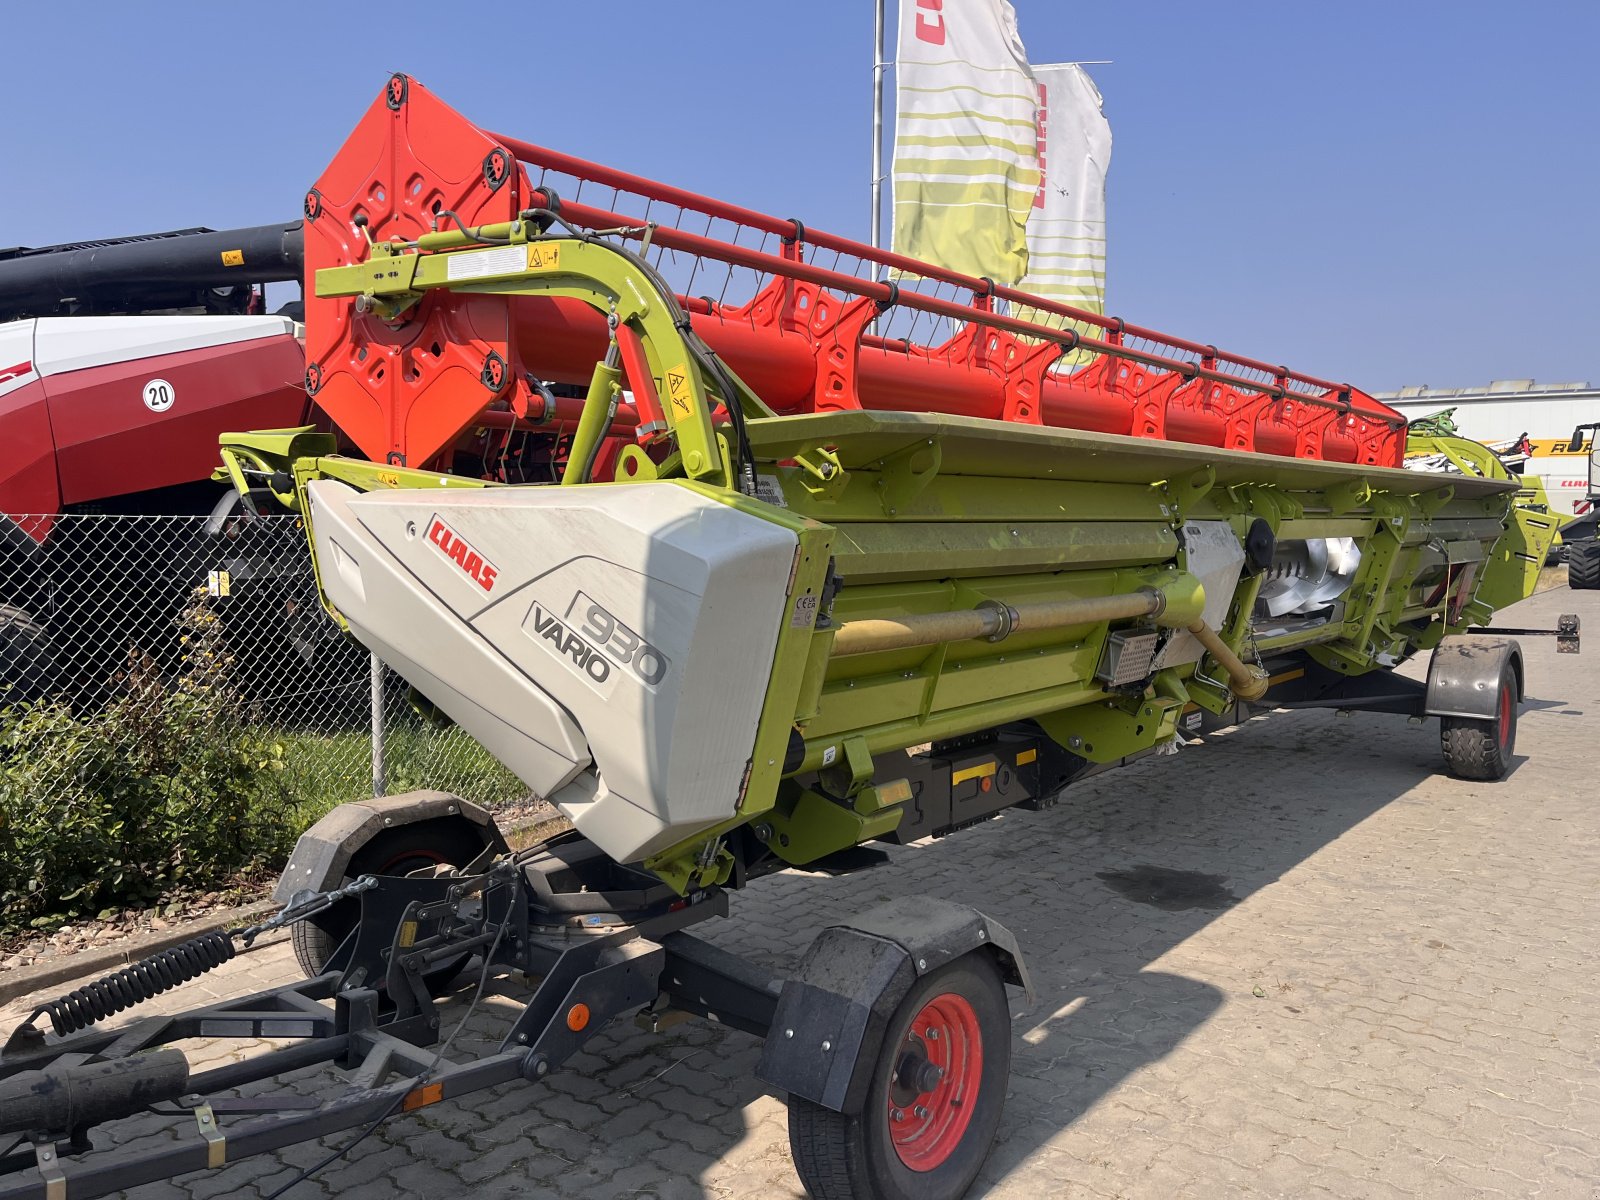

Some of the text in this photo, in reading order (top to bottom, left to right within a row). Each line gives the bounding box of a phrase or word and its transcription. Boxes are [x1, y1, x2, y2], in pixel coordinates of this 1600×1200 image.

[149, 386, 168, 406] 20
[428, 520, 498, 592] CLAAS
[533, 606, 611, 684] VARIO
[581, 604, 668, 686] 930
